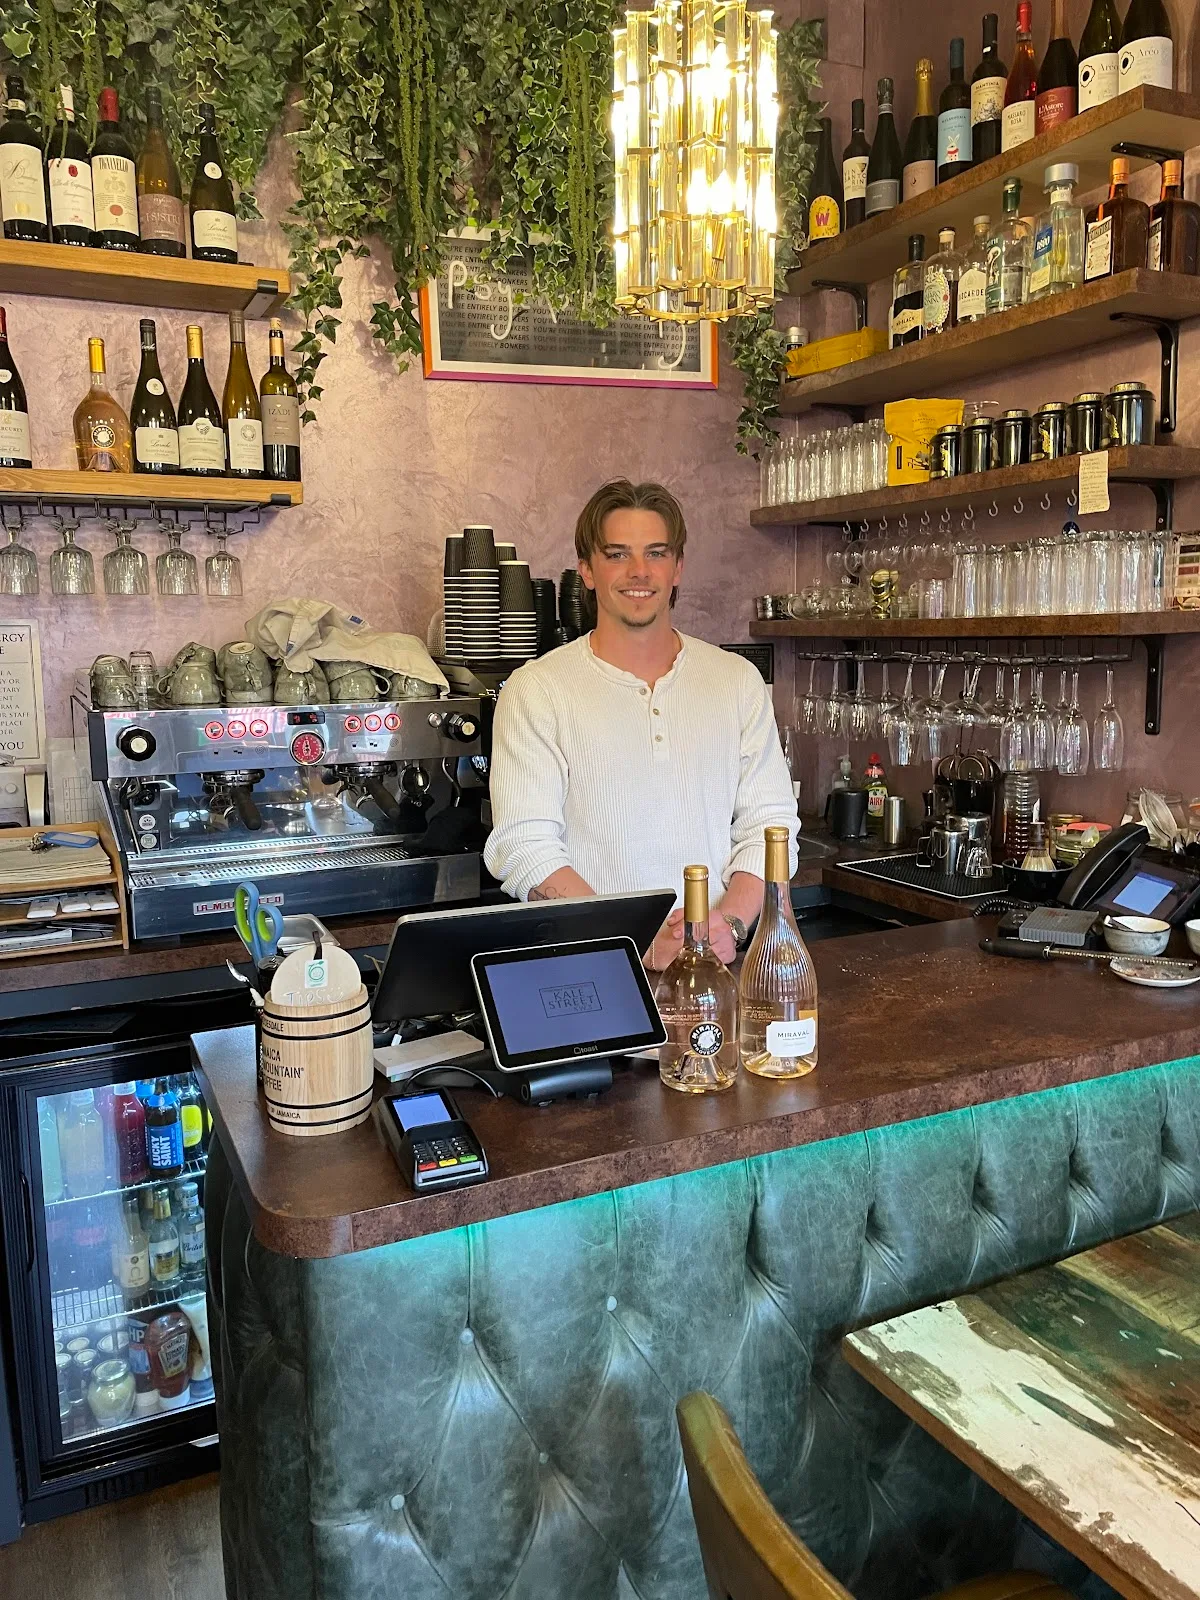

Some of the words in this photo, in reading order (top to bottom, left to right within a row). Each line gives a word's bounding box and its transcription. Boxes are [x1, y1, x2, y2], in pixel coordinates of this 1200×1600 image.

[467, 303, 497, 312] ENTIRELY
[467, 312, 498, 321] ENTIRELY
[499, 314, 529, 323] BOKERS
[500, 342, 530, 351] BONKERS
[643, 341, 670, 350] ENTIRELY
[0, 633, 25, 643] RGY
[0, 741, 25, 751] YOU
[869, 796, 884, 806] AIRY
[553, 989, 585, 1001] KALE
[548, 995, 595, 1010] STREET
[691, 1024, 722, 1040] MIRAVAL
[777, 1030, 810, 1038] MIRAVAL
[692, 1041, 721, 1056] PROVENCE
[276, 1109, 301, 1119] JAMAICA
[150, 1135, 162, 1167] LUCKY
[160, 1135, 172, 1166] SAINT
[129, 1326, 145, 1343] HP
